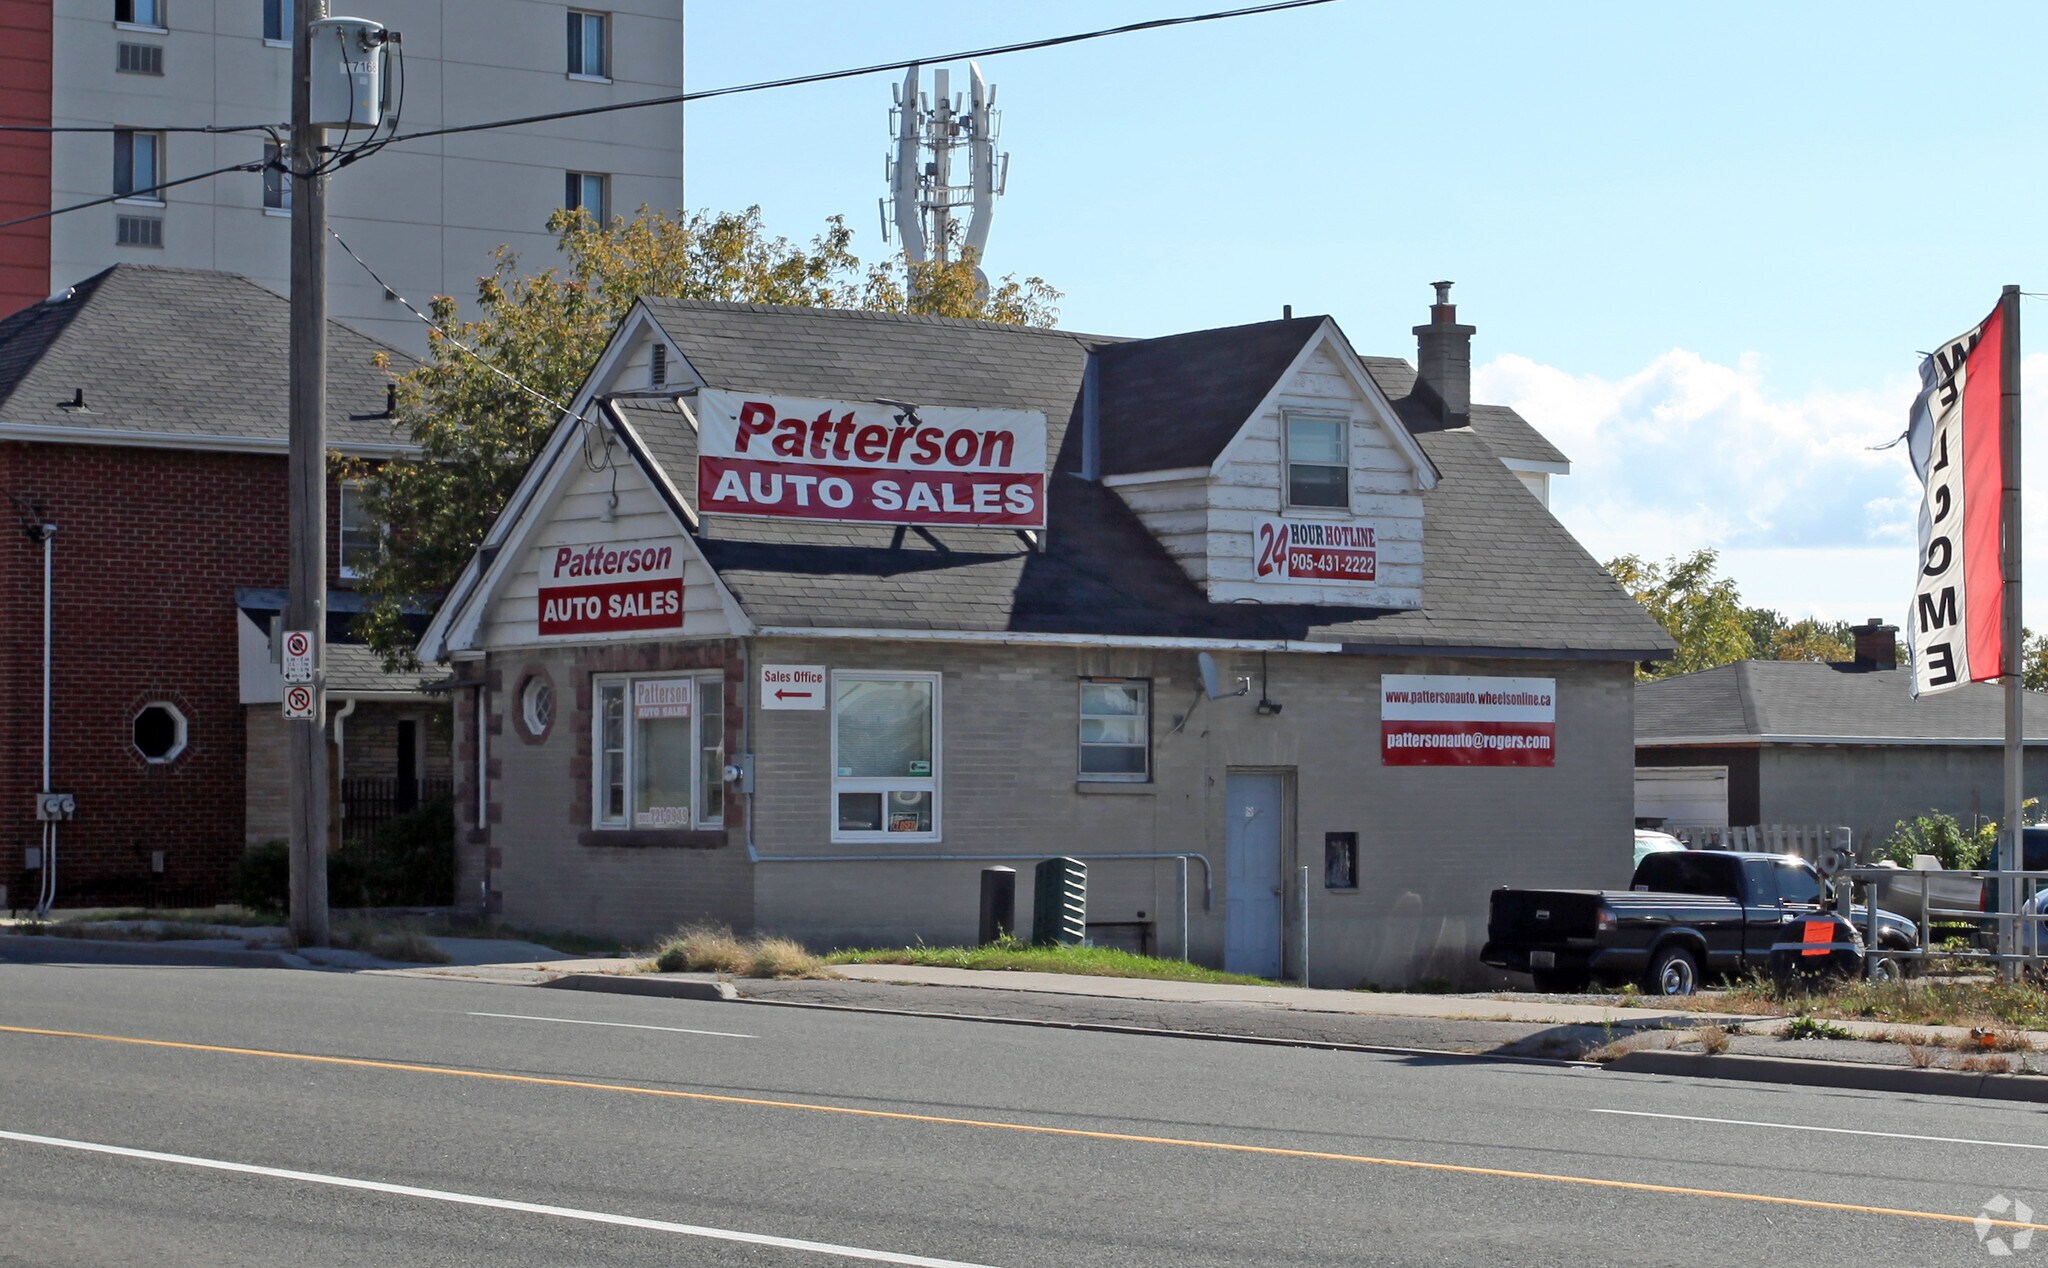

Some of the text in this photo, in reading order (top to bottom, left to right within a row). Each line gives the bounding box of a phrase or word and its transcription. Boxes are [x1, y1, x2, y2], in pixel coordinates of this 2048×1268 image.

[735, 401, 1015, 468] Patterson
[712, 469, 1035, 515] AUTO SALES
[553, 545, 673, 578] Patterson
[1257, 522, 1376, 577] 24 HOUR HOTLINE
[1291, 552, 1374, 574] 905-431-2222
[543, 590, 679, 622] AUTO SALES
[764, 670, 823, 683] Sales Office
[638, 684, 688, 704] Patterson
[1387, 732, 1550, 750] pattersonauto@rogers.com
